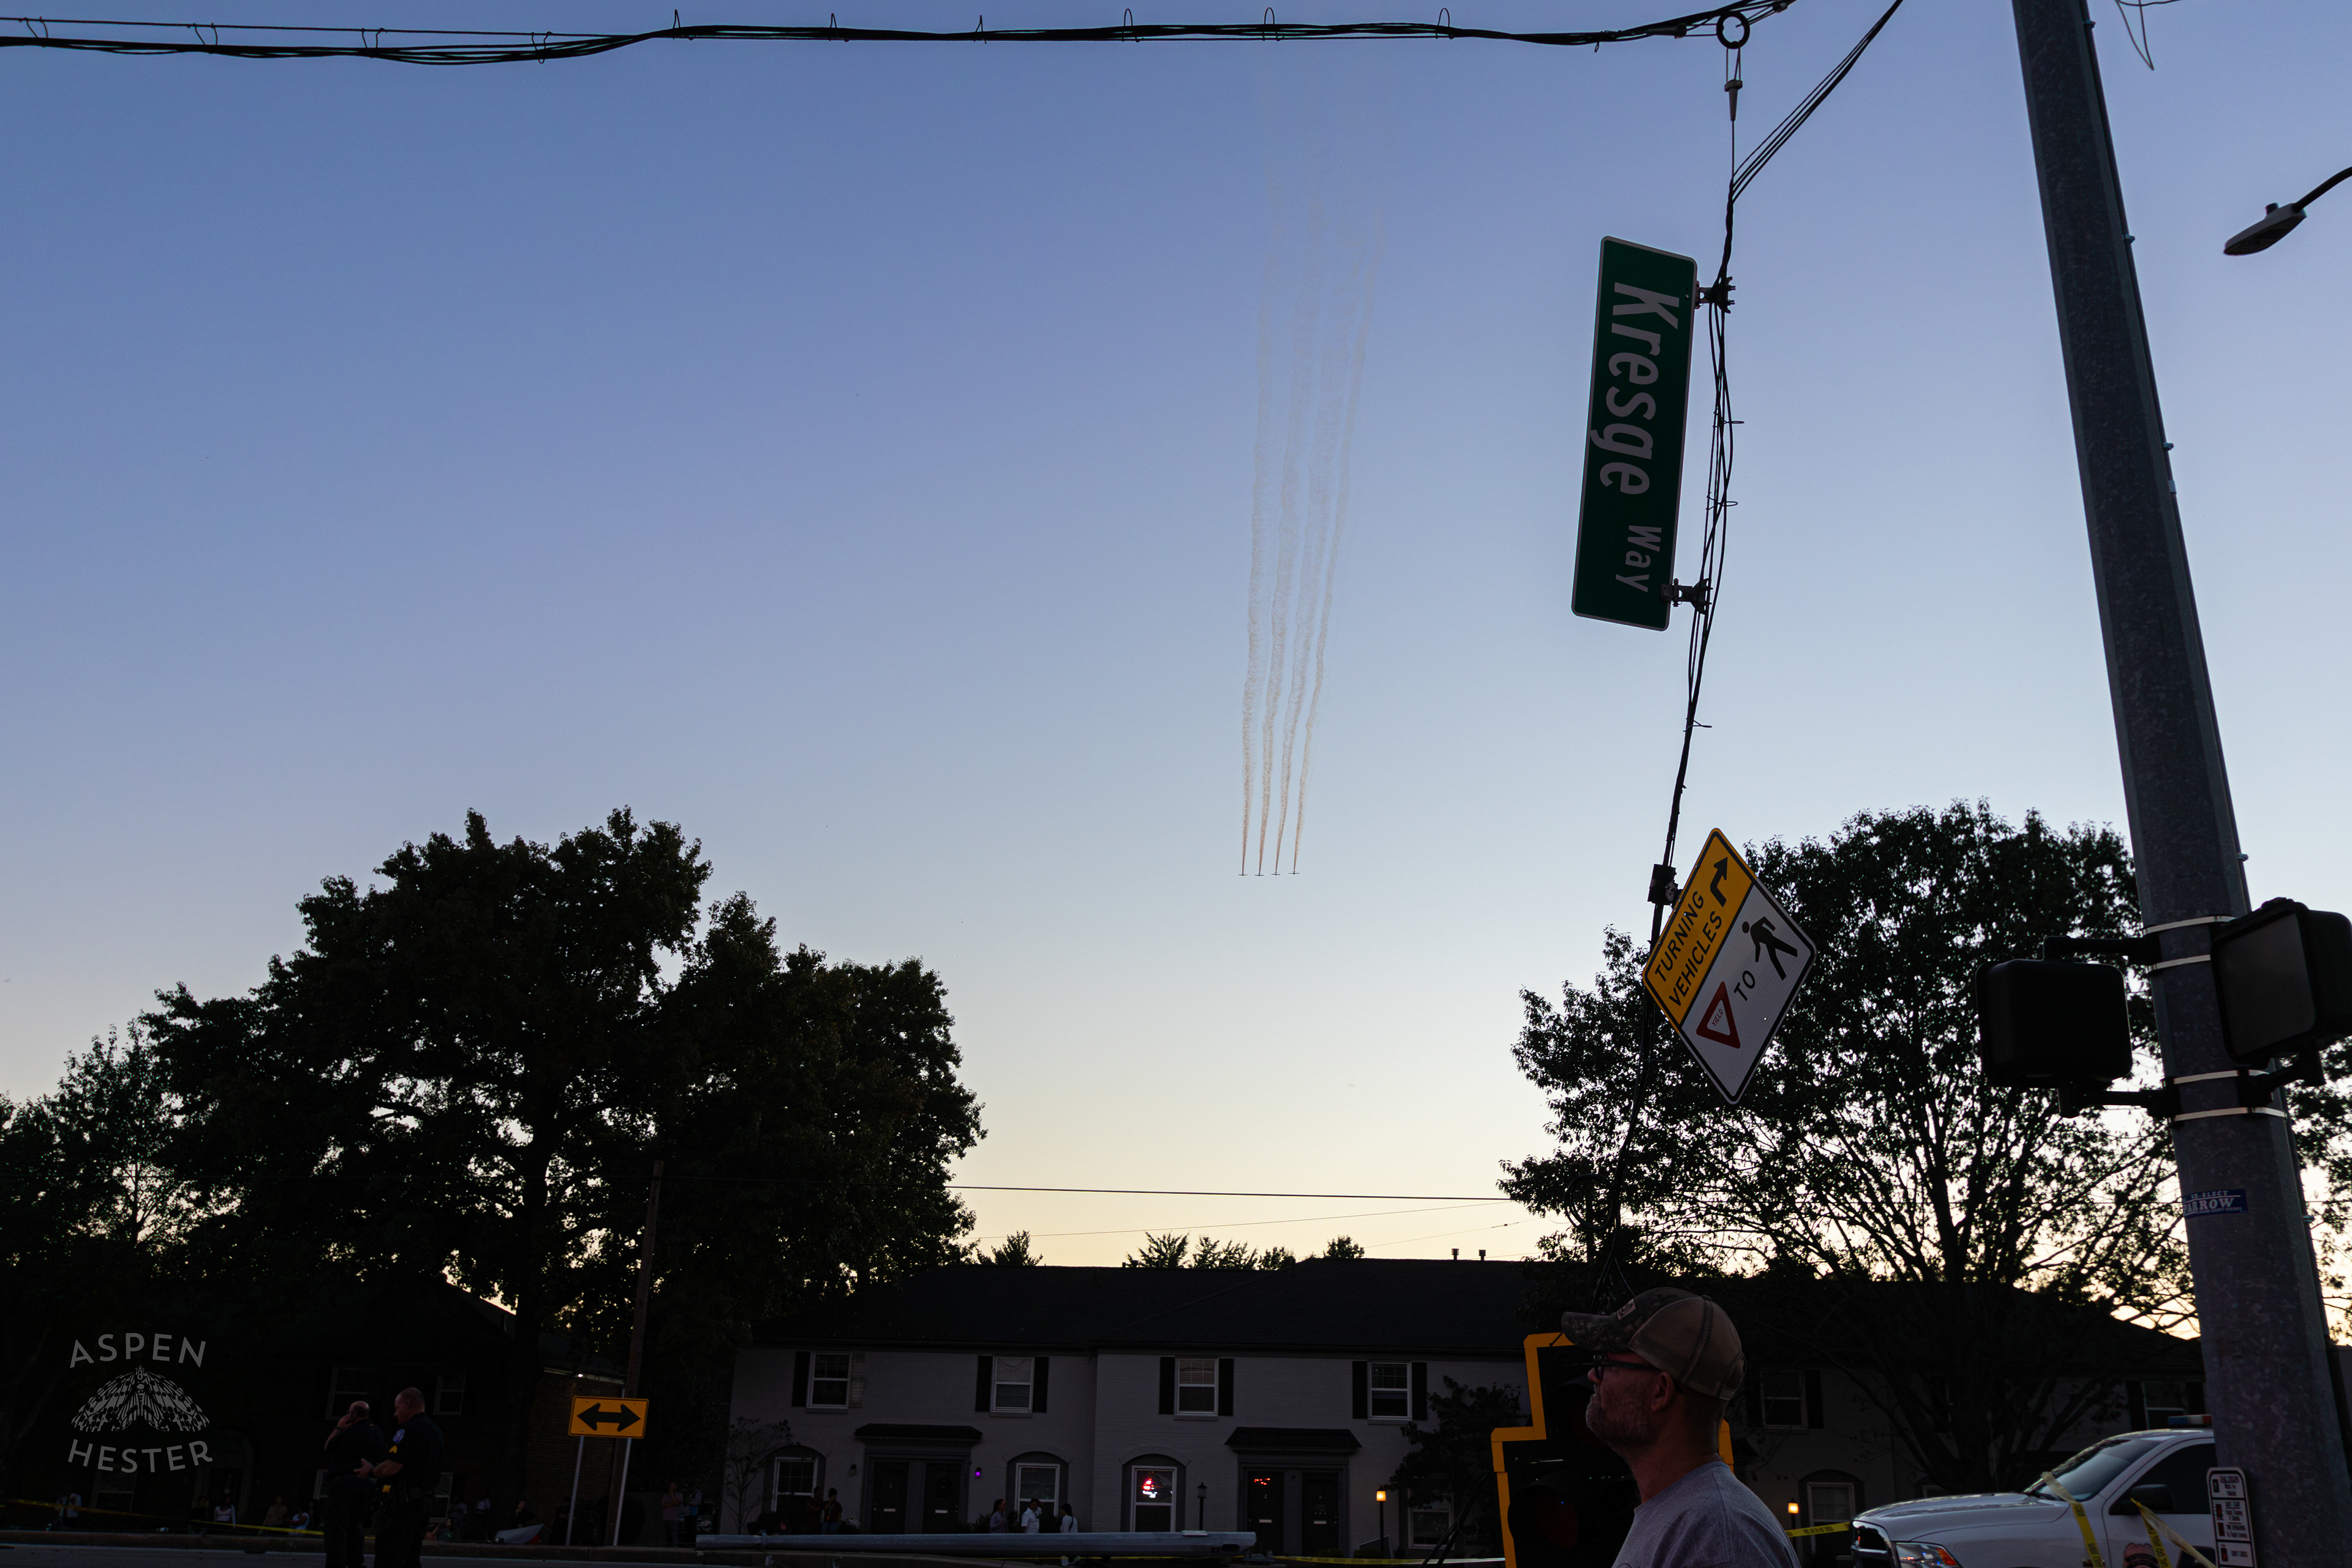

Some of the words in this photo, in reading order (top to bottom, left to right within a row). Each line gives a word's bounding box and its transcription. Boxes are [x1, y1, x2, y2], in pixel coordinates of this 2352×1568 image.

[1591, 282, 1680, 495] Kresge
[1615, 525, 1662, 593] Way
[1654, 891, 1704, 982] TURNING
[1668, 910, 1722, 1007] VEHICLES
[1711, 1008, 1724, 1027] YIELD
[1733, 970, 1755, 1002] TO
